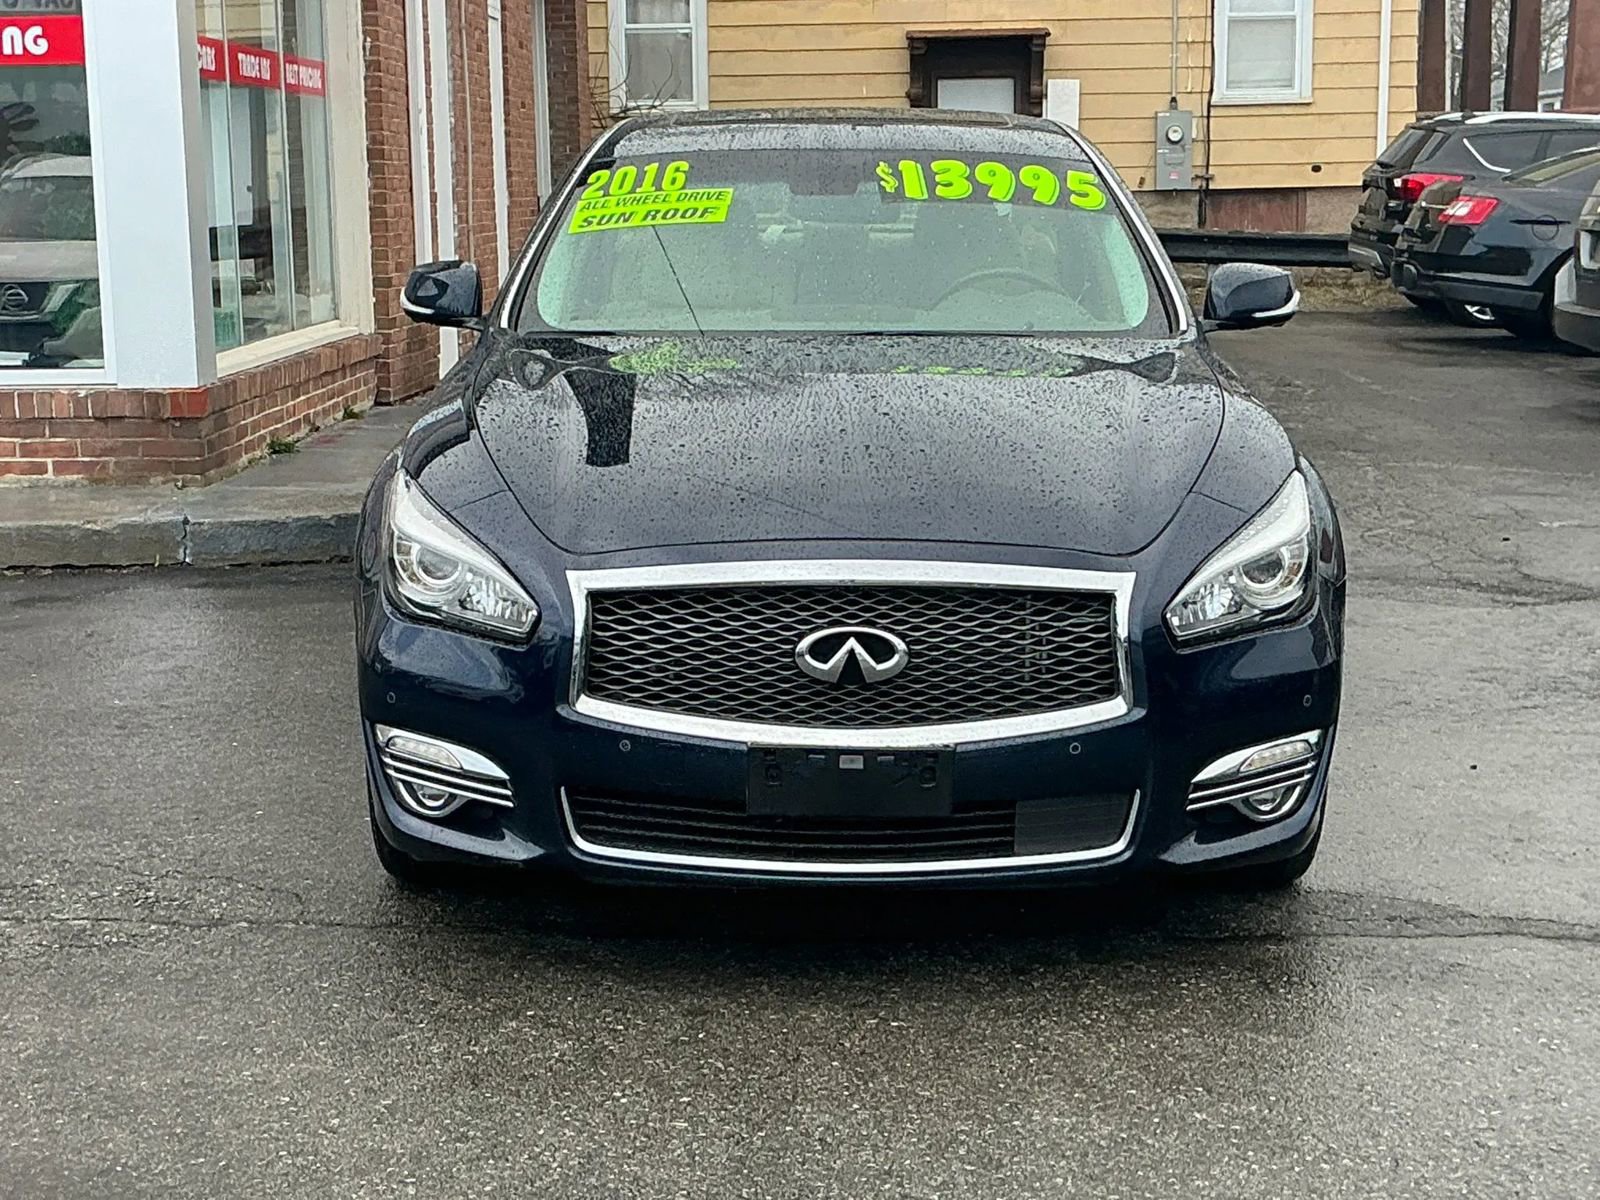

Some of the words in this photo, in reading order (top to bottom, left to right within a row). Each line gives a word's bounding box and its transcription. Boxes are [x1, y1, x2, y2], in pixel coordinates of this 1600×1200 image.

[237, 52, 260, 79] TRADE
[285, 62, 298, 86] BEST
[299, 65, 322, 88] PRICING
[581, 160, 690, 200] 2016
[875, 159, 1107, 210] $13995
[580, 200, 611, 212] ALL
[616, 192, 673, 208] WHEEL
[675, 190, 730, 203] DRIVE
[578, 210, 637, 228] SUN
[641, 206, 721, 222] ROOF
